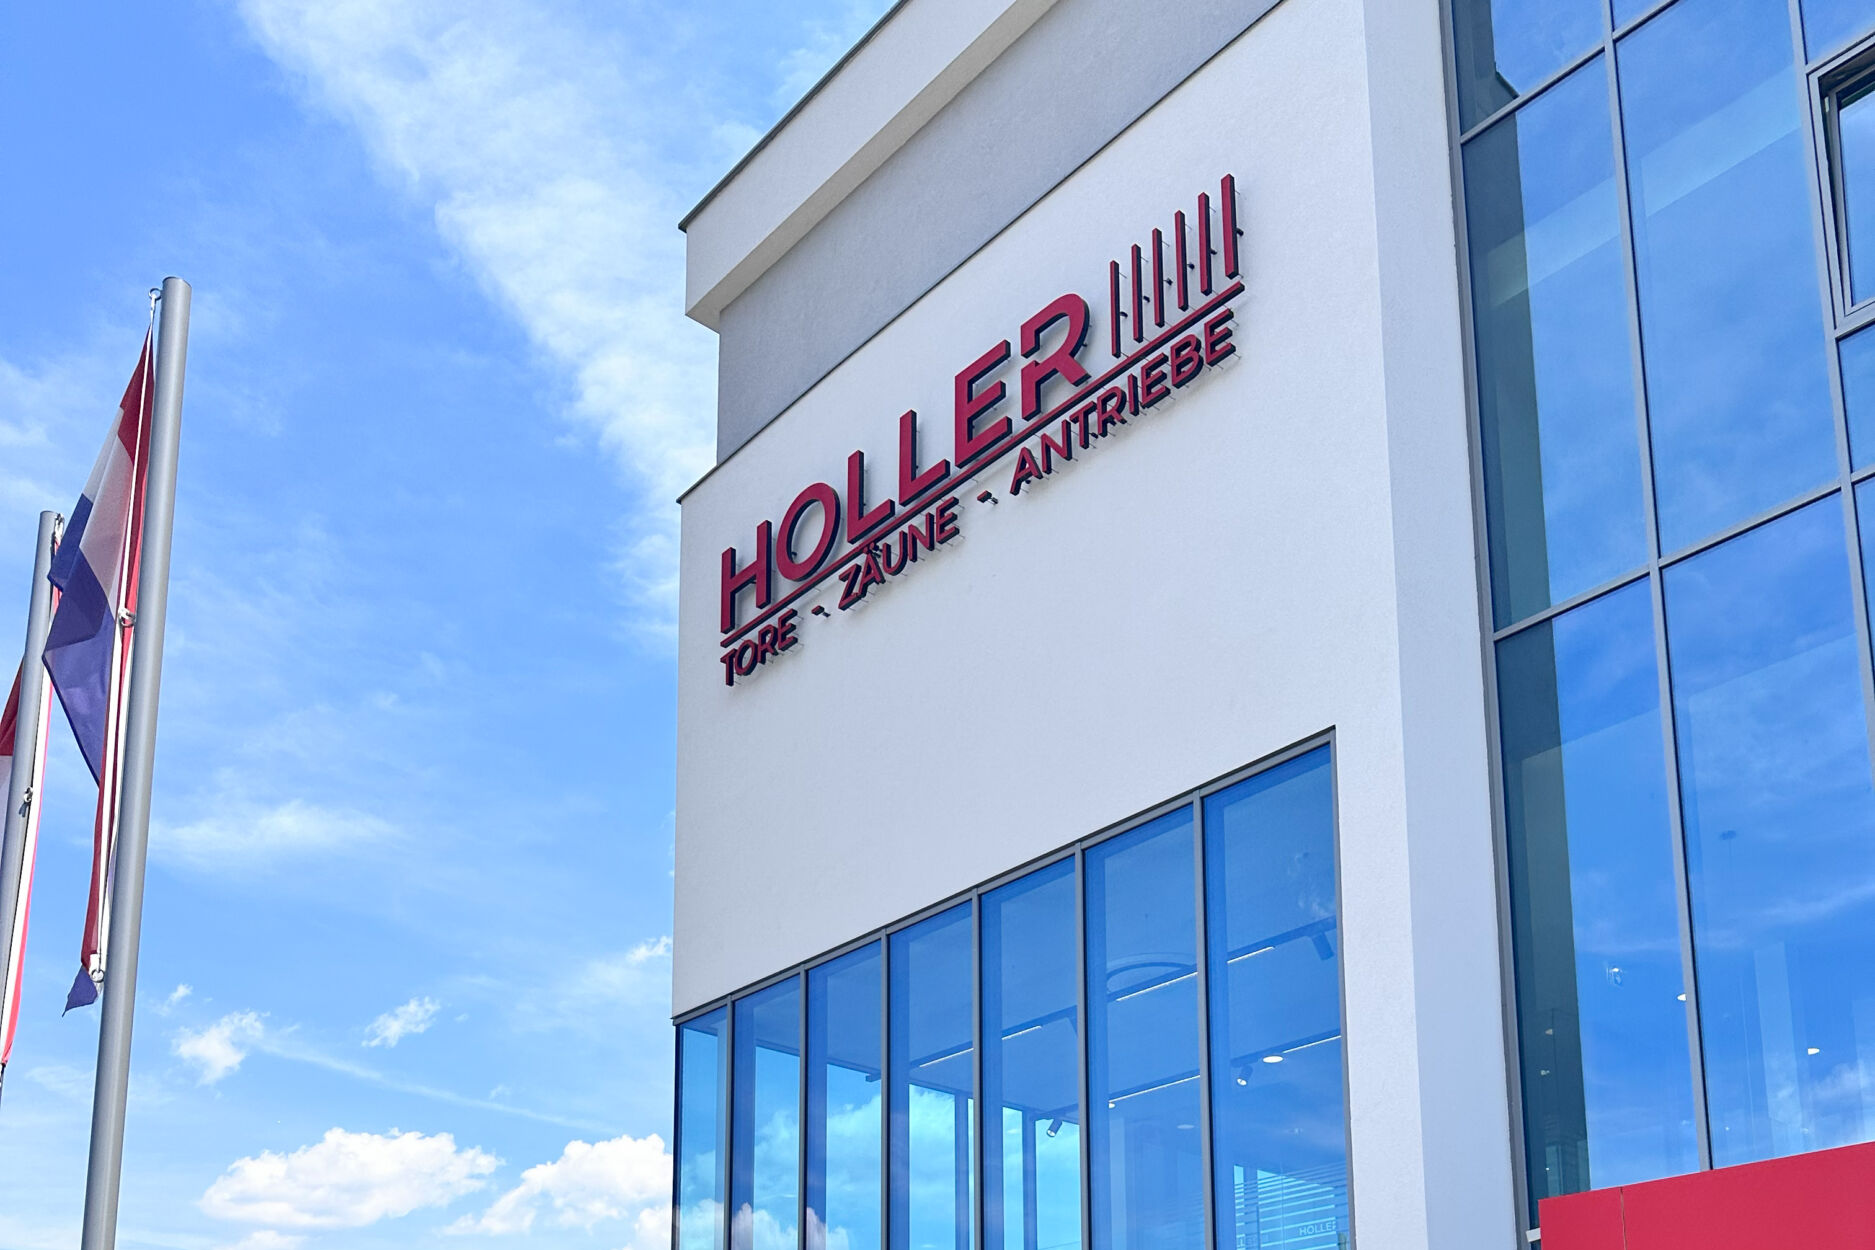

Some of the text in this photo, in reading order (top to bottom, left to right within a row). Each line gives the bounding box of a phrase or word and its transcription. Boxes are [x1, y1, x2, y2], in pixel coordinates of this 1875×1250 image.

[720, 293, 1091, 634] HOLLER
[720, 608, 798, 686] TORE
[838, 496, 960, 611] ZÄUNE
[1010, 308, 1236, 496] ANTRIEBE
